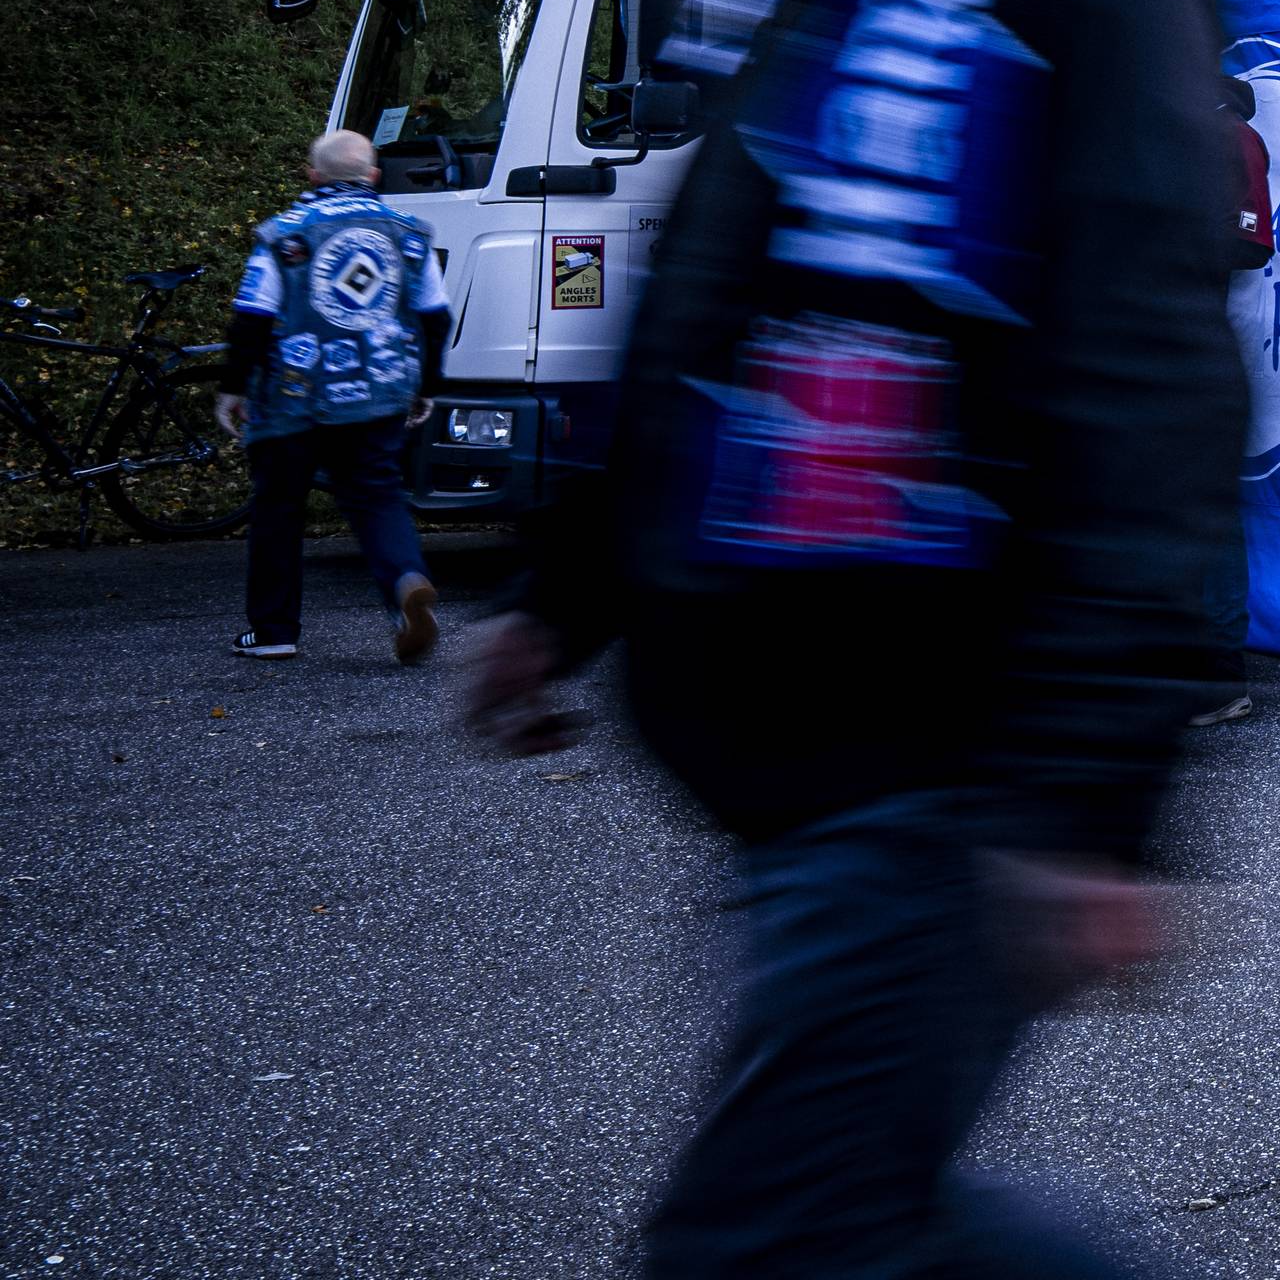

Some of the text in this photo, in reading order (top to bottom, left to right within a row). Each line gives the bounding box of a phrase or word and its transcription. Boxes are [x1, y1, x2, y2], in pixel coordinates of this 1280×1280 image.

[556, 237, 601, 245] ATTENTION
[560, 287, 597, 295] ANGLES
[562, 295, 595, 303] MORTS
